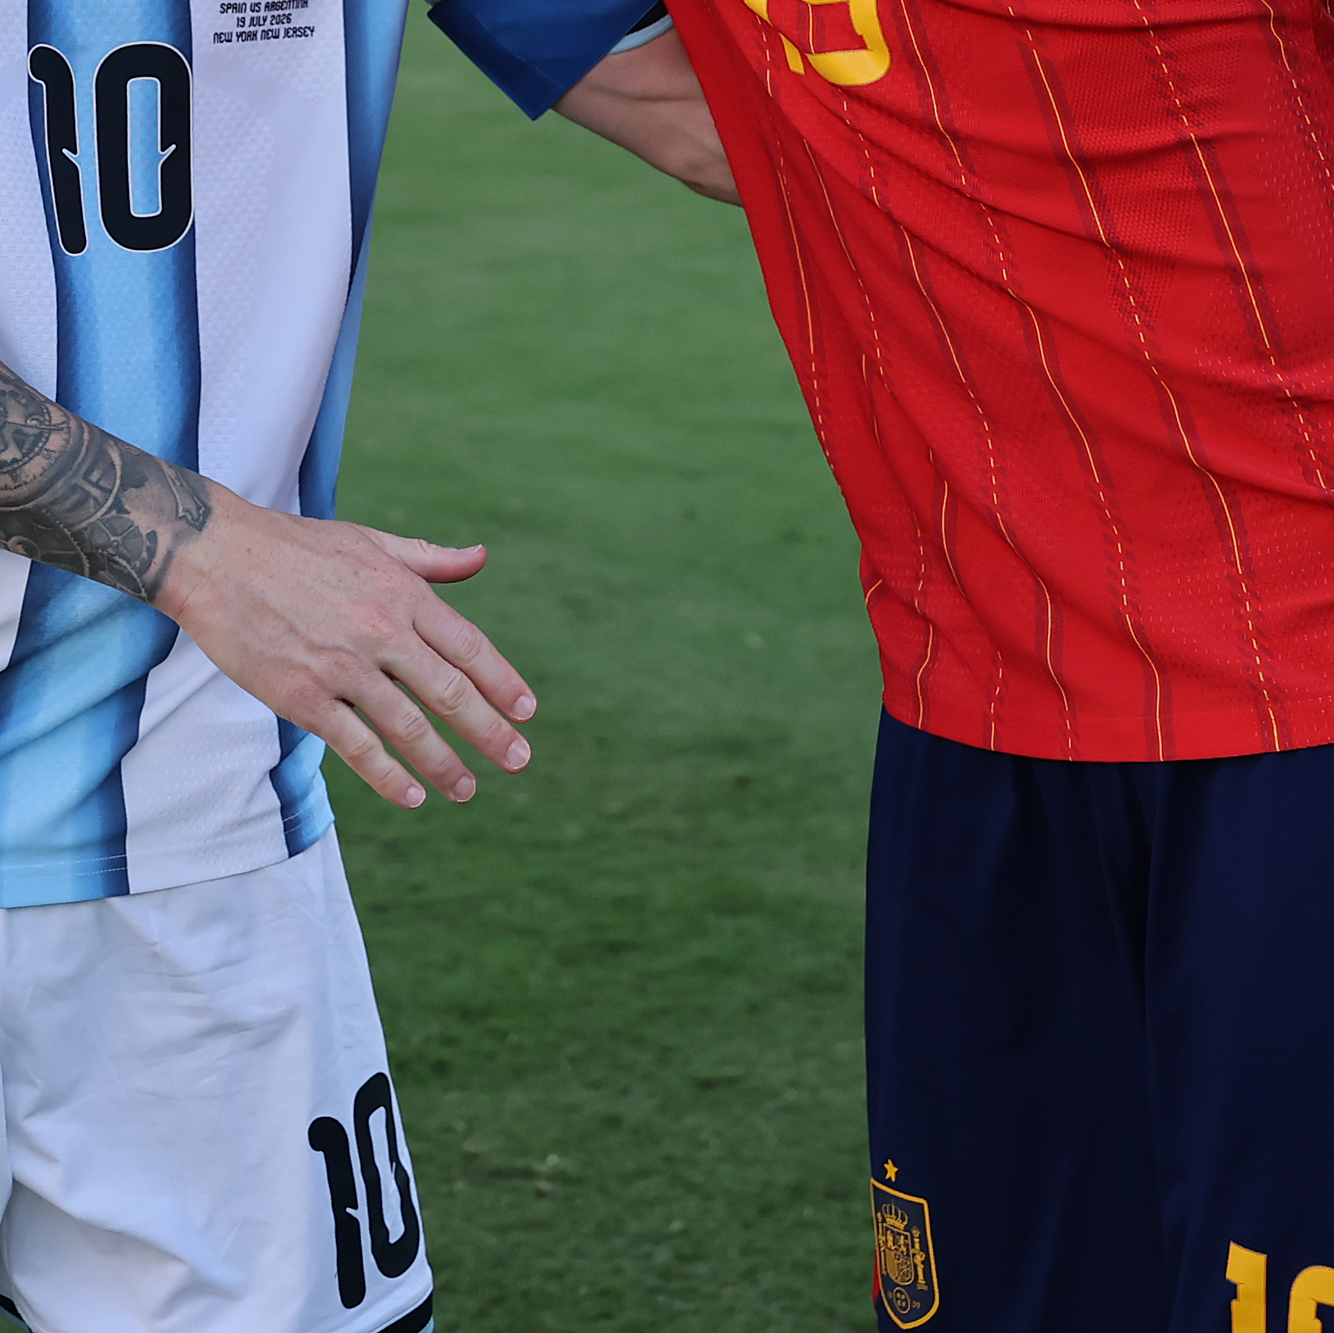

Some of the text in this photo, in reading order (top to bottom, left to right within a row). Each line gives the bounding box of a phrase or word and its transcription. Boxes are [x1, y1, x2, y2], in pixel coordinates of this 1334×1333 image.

[219, 2, 247, 14] SPAIN
[236, 13, 292, 28] 19 JULY 2026
[213, 25, 315, 44] NEW YORK NEW JERSEY
[28, 41, 194, 256] 10
[308, 1072, 421, 1309] 10
